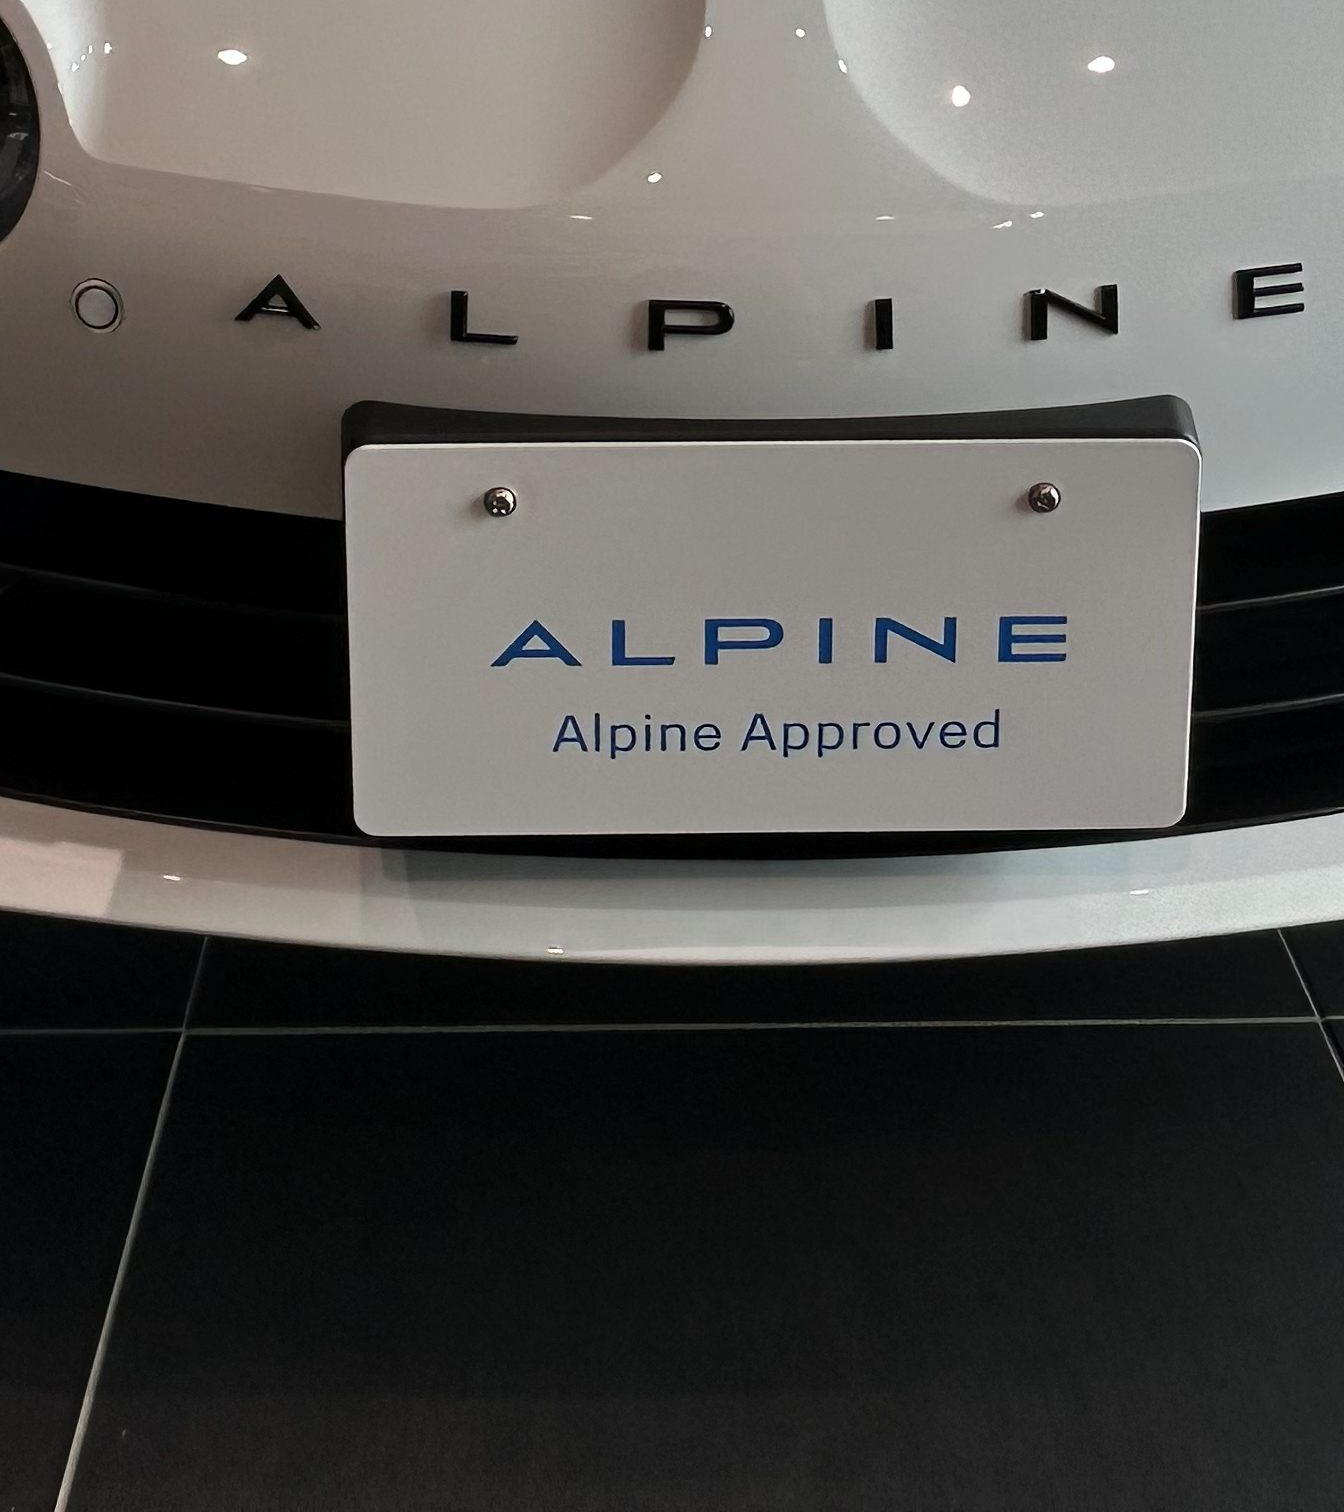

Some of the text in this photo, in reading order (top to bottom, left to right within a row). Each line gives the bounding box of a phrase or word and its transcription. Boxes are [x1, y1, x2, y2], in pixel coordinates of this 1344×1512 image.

[230, 262, 1305, 354] ALPINE
[491, 615, 1069, 667] ALPINE
[552, 708, 1002, 760] Alpine Approved
